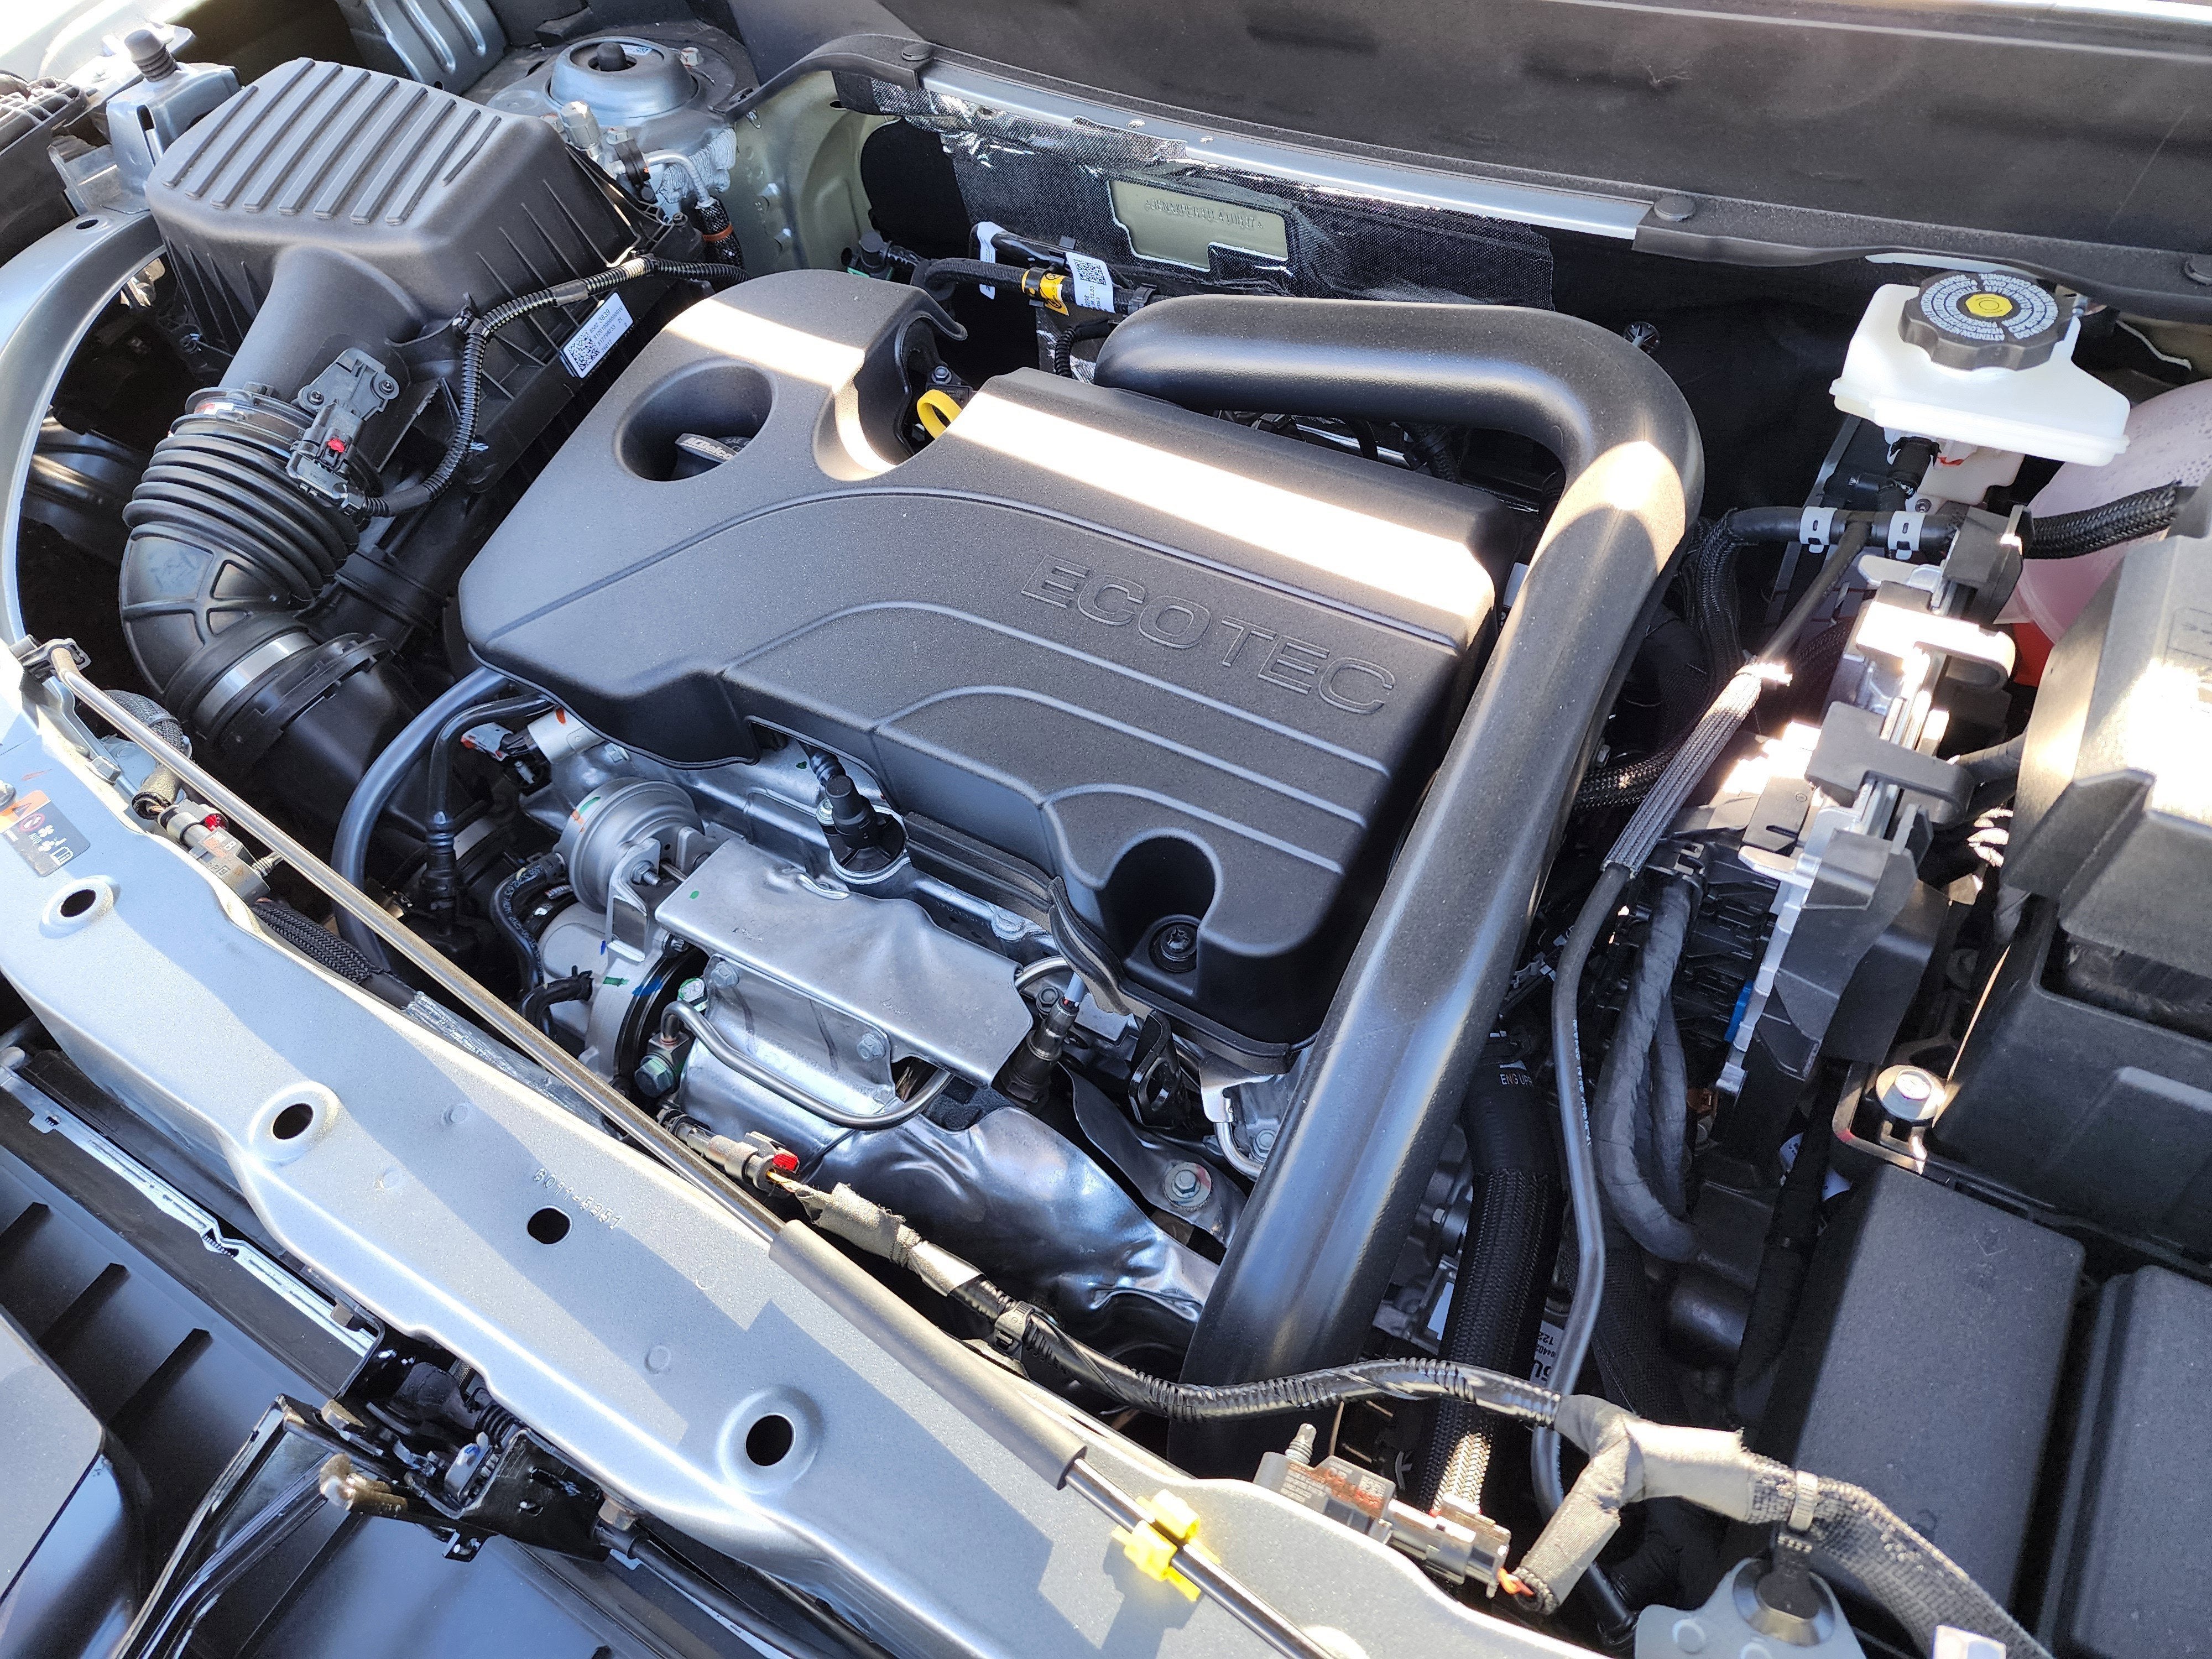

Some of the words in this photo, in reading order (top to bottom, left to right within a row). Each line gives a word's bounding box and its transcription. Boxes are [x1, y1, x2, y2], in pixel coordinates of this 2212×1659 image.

[598, 308, 611, 324] 3839
[684, 437, 733, 461] ACDelco
[1021, 555, 1395, 714] ECOTEC
[28, 832, 43, 845] AUTO
[1499, 1073, 1519, 1085] ENG
